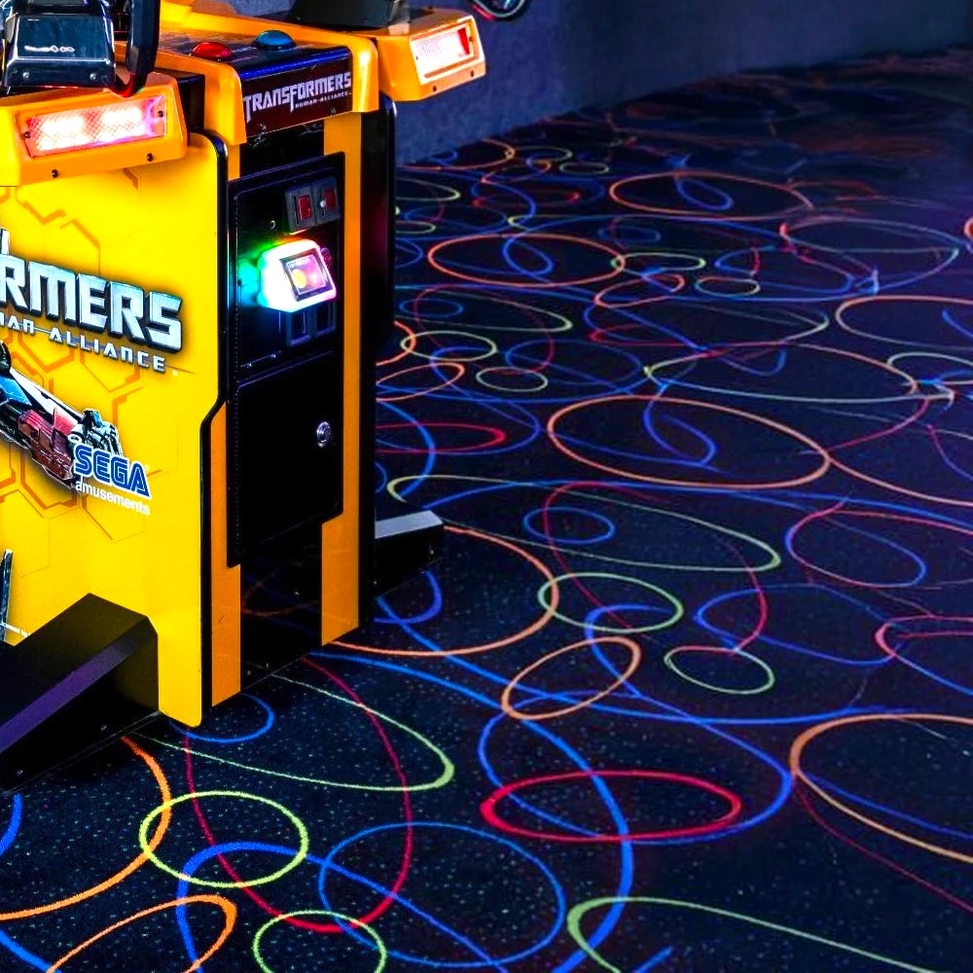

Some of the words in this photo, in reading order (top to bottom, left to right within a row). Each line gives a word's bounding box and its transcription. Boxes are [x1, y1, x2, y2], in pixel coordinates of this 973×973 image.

[243, 71, 352, 124] TRANSFORMERS
[48, 326, 168, 374] ALLIANCE
[73, 442, 152, 501] SEGA
[75, 479, 151, 516] amusements
